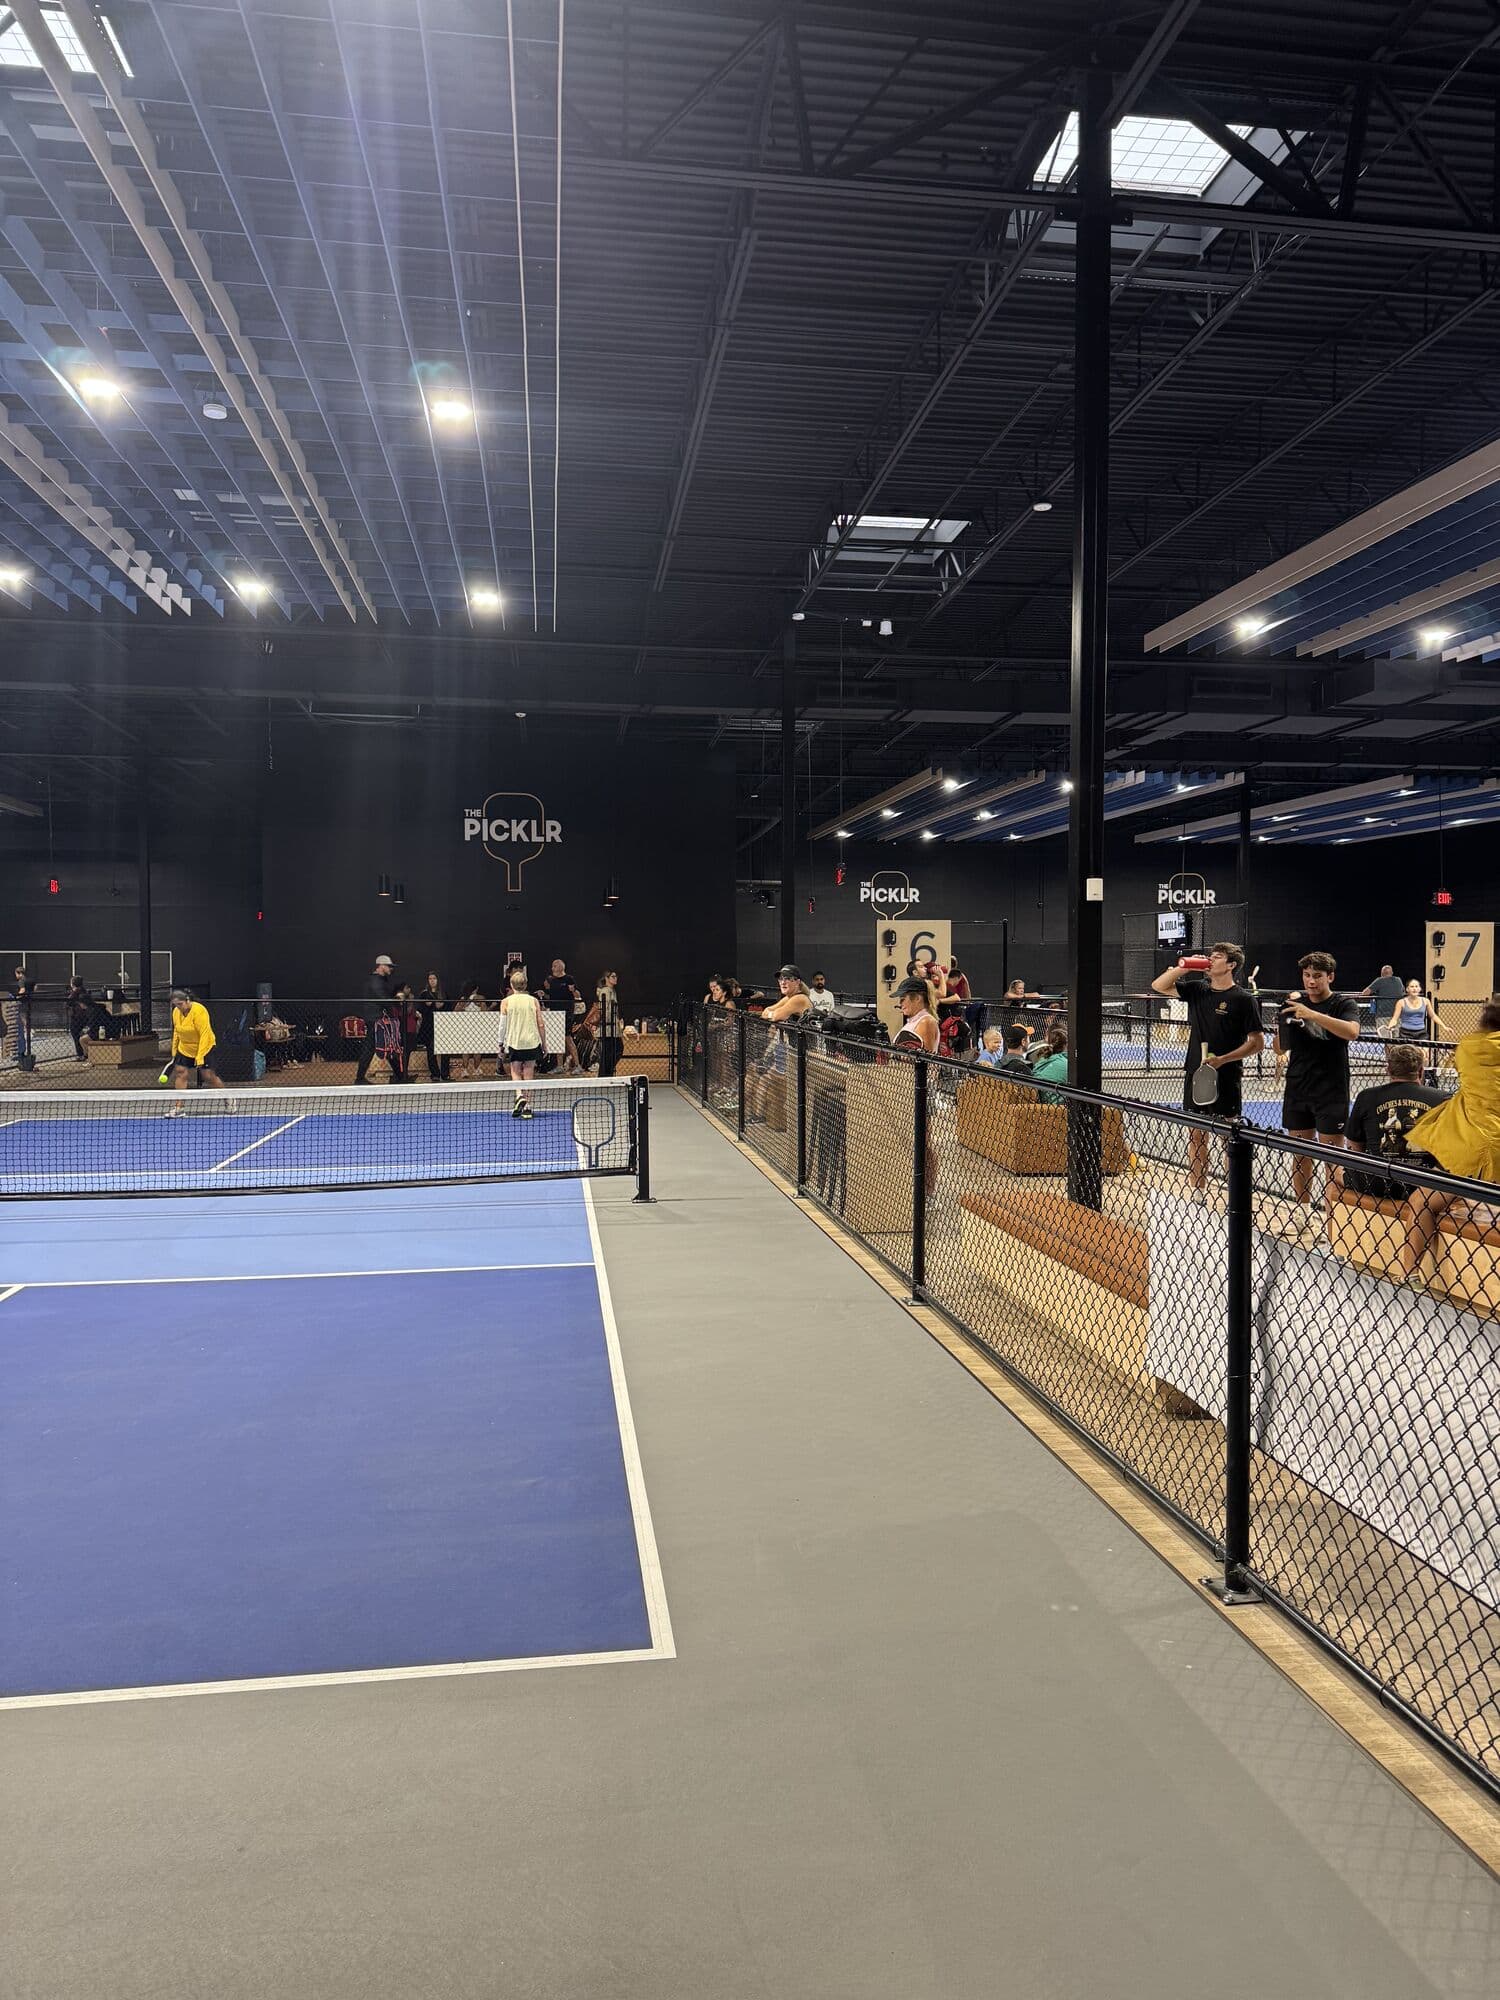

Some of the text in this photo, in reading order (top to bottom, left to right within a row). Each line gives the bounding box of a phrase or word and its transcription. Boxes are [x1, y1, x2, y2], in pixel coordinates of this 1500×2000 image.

[464, 809, 482, 817] THE
[464, 818, 562, 843] PICKLR
[860, 887, 920, 903] PICKLR
[1158, 889, 1216, 904] PICKLR
[911, 931, 937, 963] 6
[1457, 932, 1480, 967] 7
